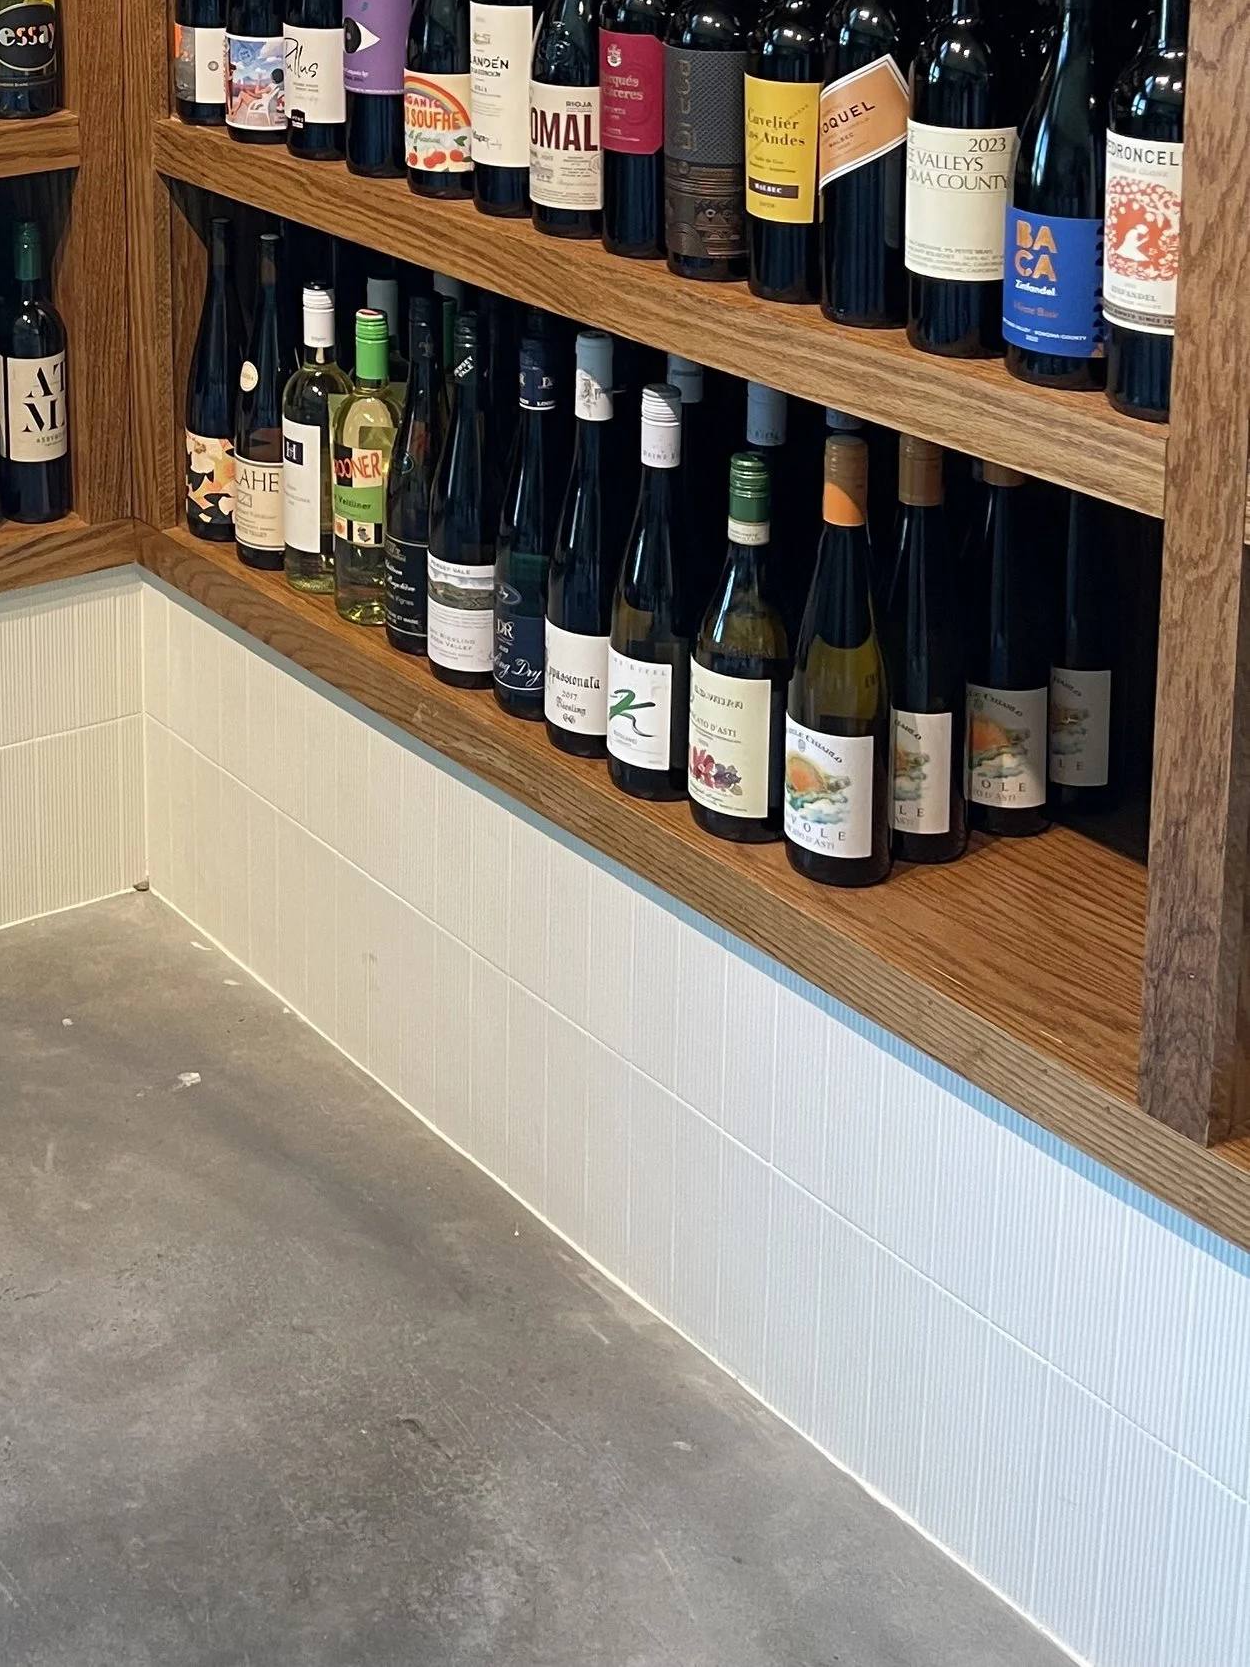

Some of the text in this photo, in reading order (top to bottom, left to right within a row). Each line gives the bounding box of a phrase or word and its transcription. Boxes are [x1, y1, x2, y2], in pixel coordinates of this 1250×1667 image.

[565, 100, 593, 108] RIOJA
[411, 109, 461, 131] SOUFRE
[821, 100, 876, 135] OQUEL
[762, 132, 806, 147] Andes
[969, 137, 1007, 153] 2023
[916, 151, 984, 173] VALLEYS
[936, 173, 1008, 191] COUNTY
[1016, 219, 1058, 254] BA
[1014, 249, 1058, 283] CA
[511, 658, 543, 687] Dry
[555, 695, 587, 717] Riesling
[561, 689, 578, 701] 2017
[710, 722, 737, 738] D'ASTI
[805, 734, 844, 764] CHIARLO
